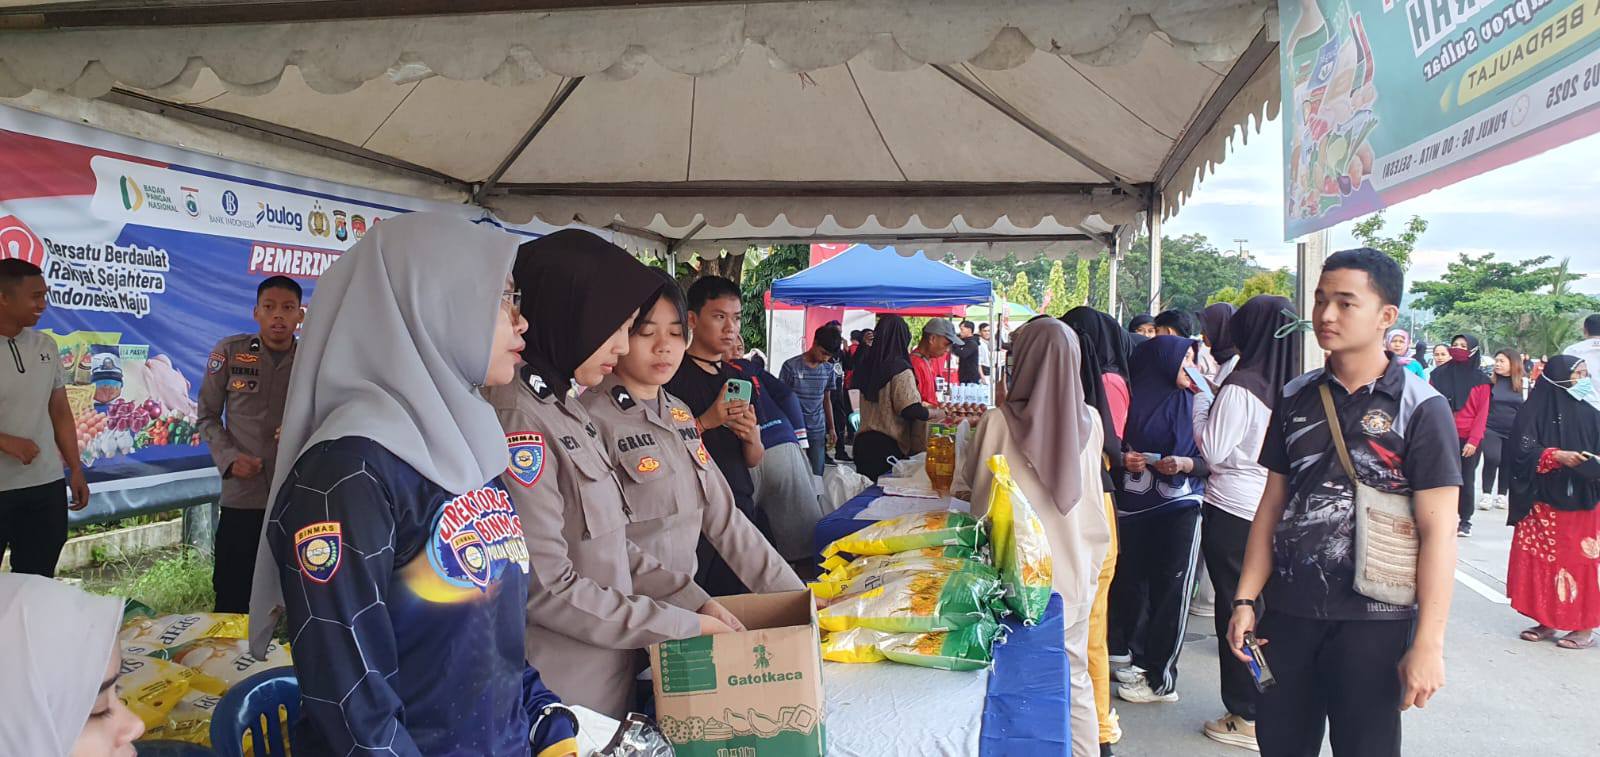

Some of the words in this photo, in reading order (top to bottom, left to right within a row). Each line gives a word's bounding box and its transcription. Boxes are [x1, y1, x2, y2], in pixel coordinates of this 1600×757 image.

[266, 203, 303, 231] bulog
[43, 238, 101, 261] Bersatu
[105, 245, 168, 268] Berdaulat
[48, 261, 96, 286] Rakyat
[97, 268, 163, 292] Sejahtera
[48, 286, 118, 309] Indonesia
[118, 293, 148, 315] Maju
[507, 435, 540, 443] INMAS
[617, 433, 656, 453] GRACE
[298, 525, 335, 540] BINMAS
[474, 514, 525, 543] BINMS
[160, 616, 200, 645] SPHP
[727, 671, 803, 687] Gatotkaca
